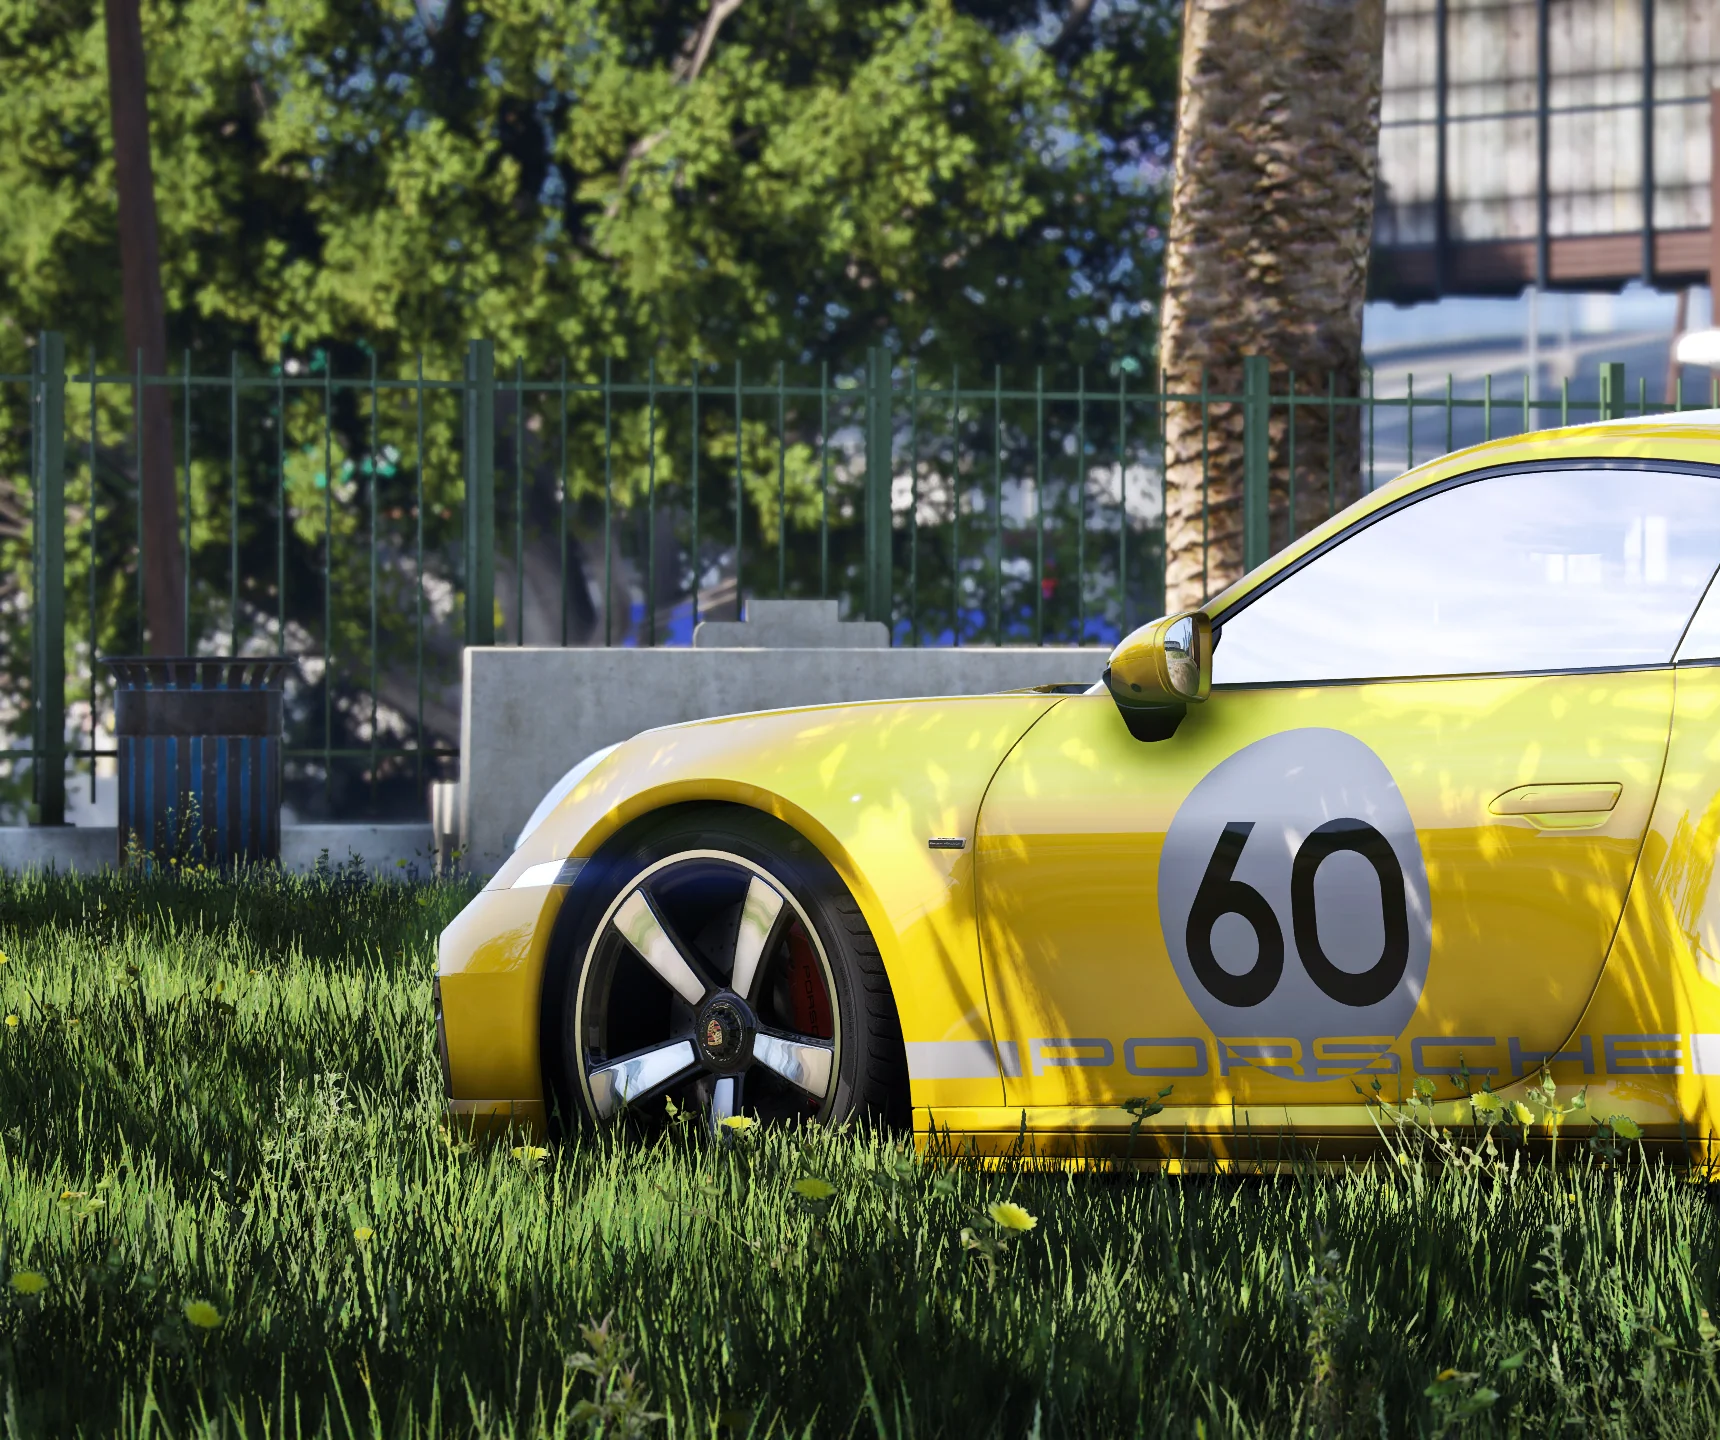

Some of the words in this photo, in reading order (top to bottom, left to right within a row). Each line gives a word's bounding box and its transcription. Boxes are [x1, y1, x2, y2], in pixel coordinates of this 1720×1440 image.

[1186, 817, 1410, 1008] 60
[803, 965, 819, 1036] PORSC
[1028, 1034, 1685, 1077] PORSCHE
